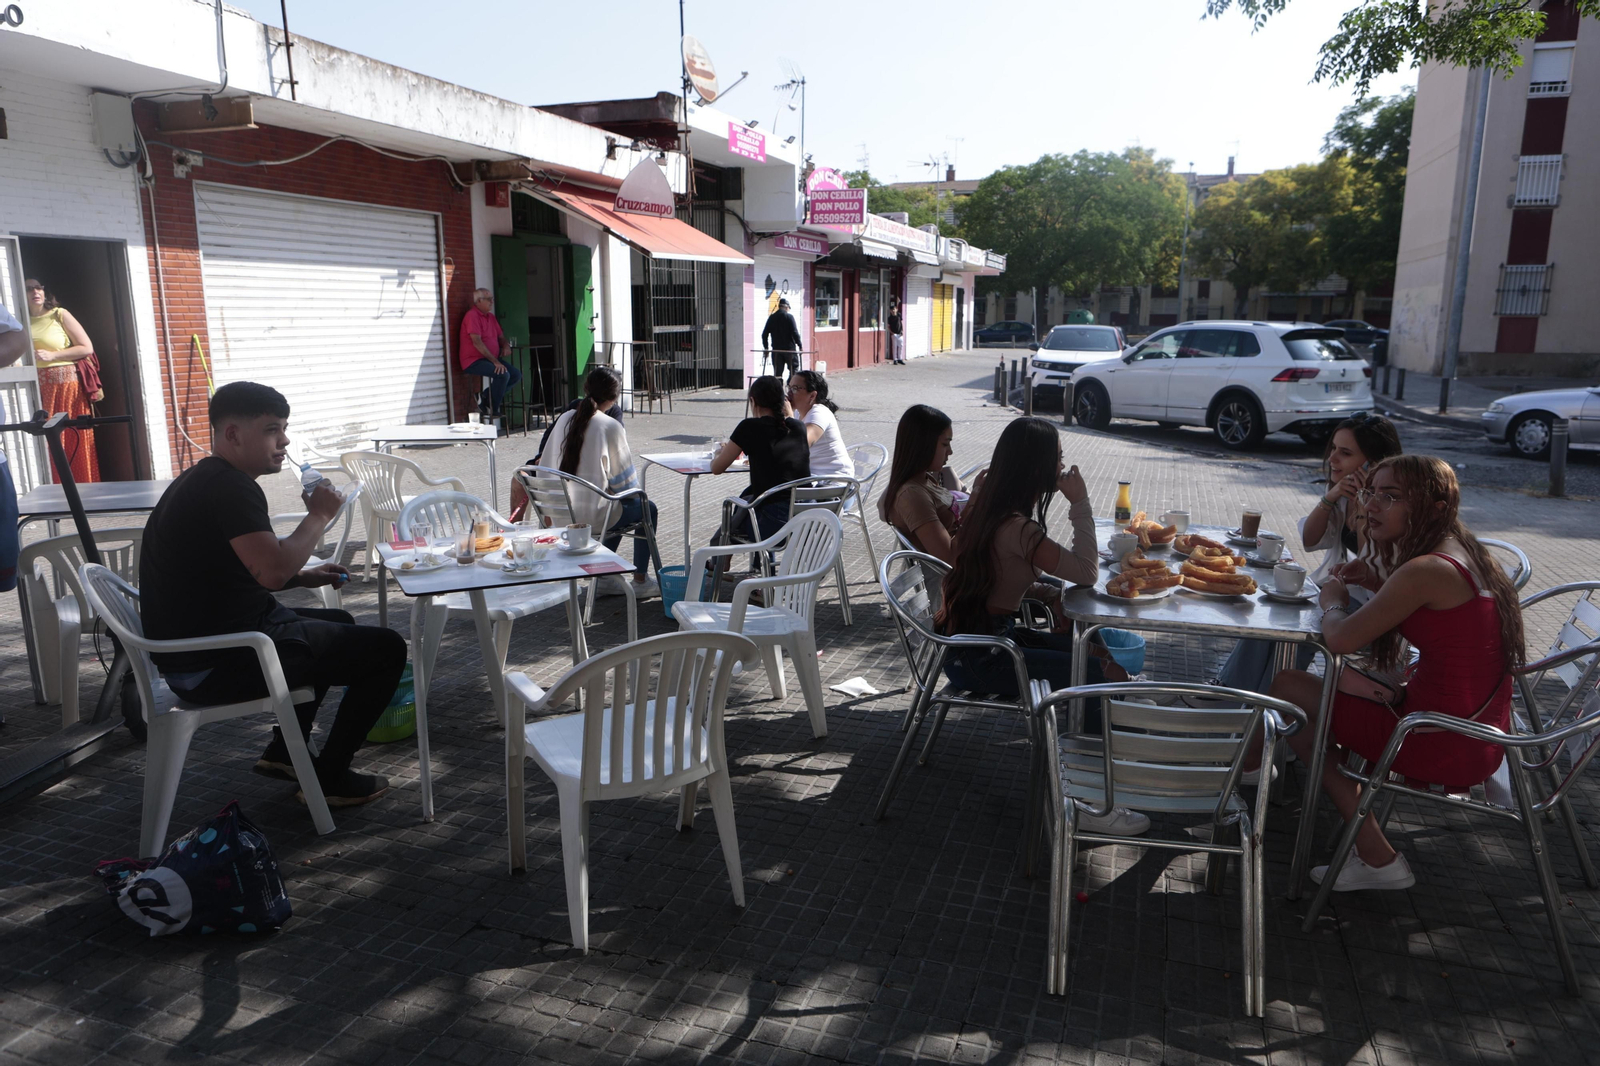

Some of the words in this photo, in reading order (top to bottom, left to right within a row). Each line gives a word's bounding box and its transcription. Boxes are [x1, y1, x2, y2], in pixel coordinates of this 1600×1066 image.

[808, 170, 825, 191] DON
[811, 191, 829, 200] DON
[830, 190, 864, 200] CERILLO
[616, 196, 673, 216] Cruzcampo
[815, 202, 833, 211] DON
[834, 201, 860, 211] POLLO
[813, 213, 861, 223] 955095278
[783, 235, 798, 249] DON
[799, 238, 822, 252] CERILLO
